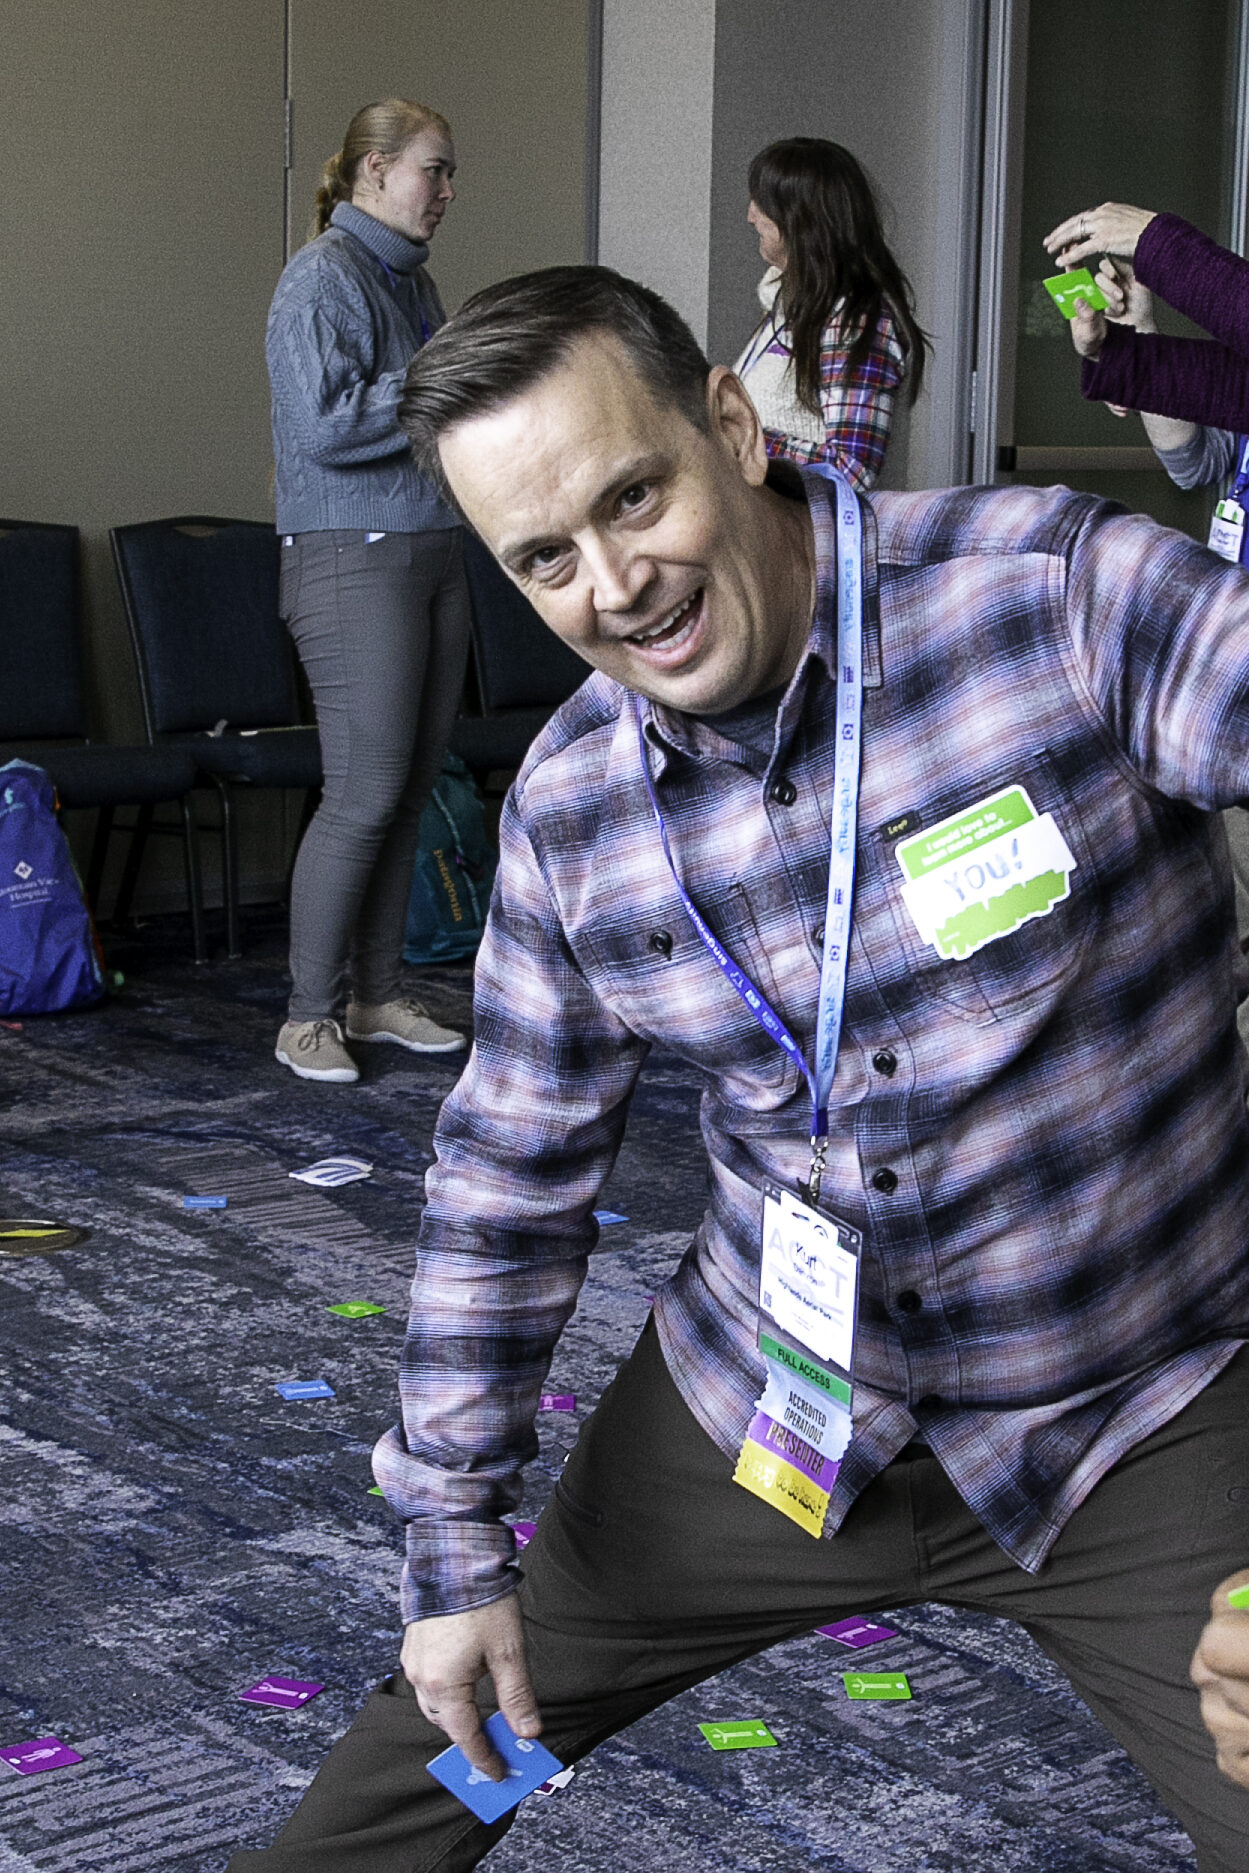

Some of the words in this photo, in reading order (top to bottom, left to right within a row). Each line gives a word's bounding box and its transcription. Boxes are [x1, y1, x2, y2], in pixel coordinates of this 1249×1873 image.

[983, 812, 997, 824] to
[778, 1348, 798, 1369] FULL
[798, 1361, 831, 1389] ACCESS
[784, 1407, 824, 1446] OPERATIONS
[788, 1391, 827, 1428] ACCREDITED
[766, 1421, 825, 1476] PRESENTER
